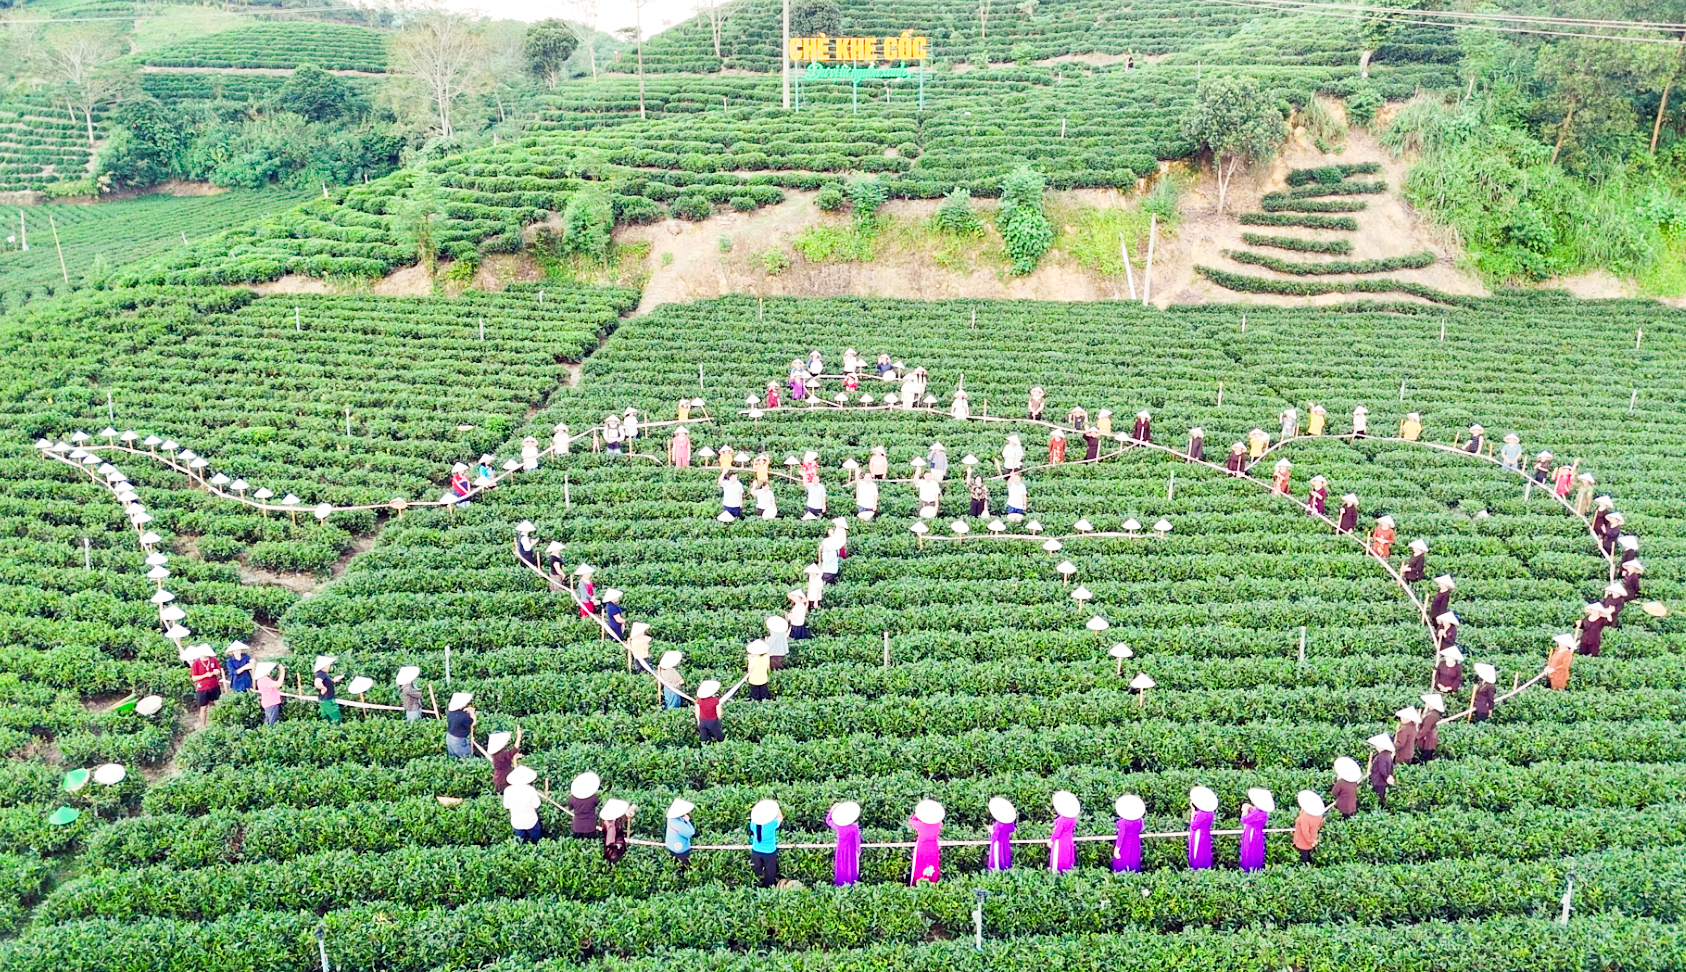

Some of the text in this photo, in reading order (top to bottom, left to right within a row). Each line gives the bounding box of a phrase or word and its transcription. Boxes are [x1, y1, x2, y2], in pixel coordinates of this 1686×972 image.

[789, 28, 927, 61] CHÈ KHE CỐC
